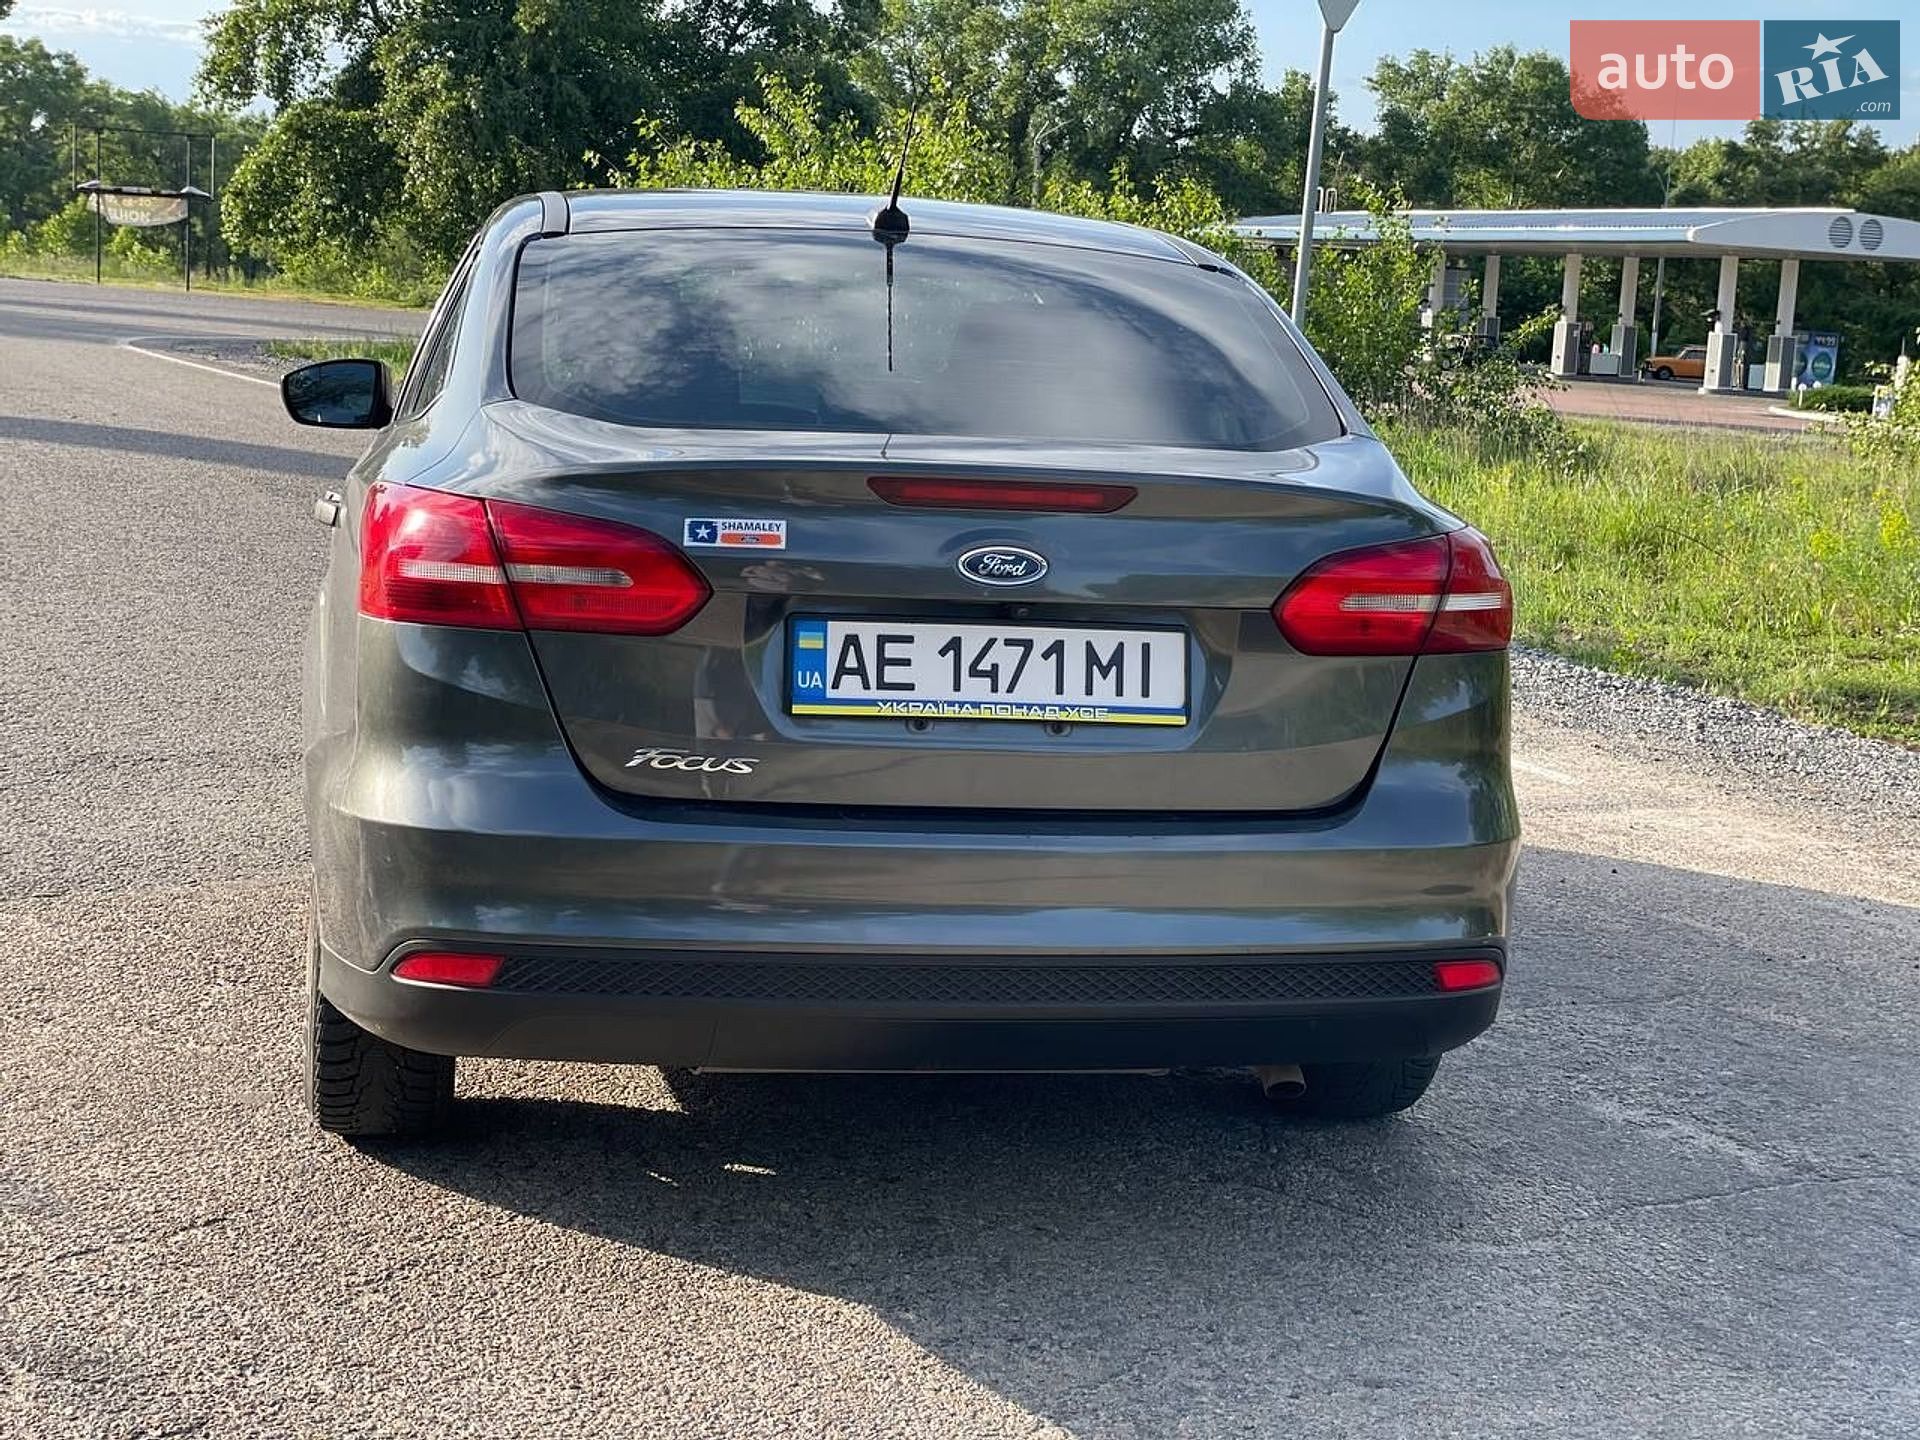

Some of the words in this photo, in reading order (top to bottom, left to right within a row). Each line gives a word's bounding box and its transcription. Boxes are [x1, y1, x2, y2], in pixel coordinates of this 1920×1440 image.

[721, 520, 782, 532] SHAMALEY
[978, 554, 1027, 577] Ford
[832, 634, 915, 692] AE
[938, 636, 1064, 696] 1471
[1086, 641, 1150, 699] MI
[797, 671, 823, 689] UA
[876, 699, 972, 715] УКРАЇНА
[980, 703, 1059, 719] ПОНАД
